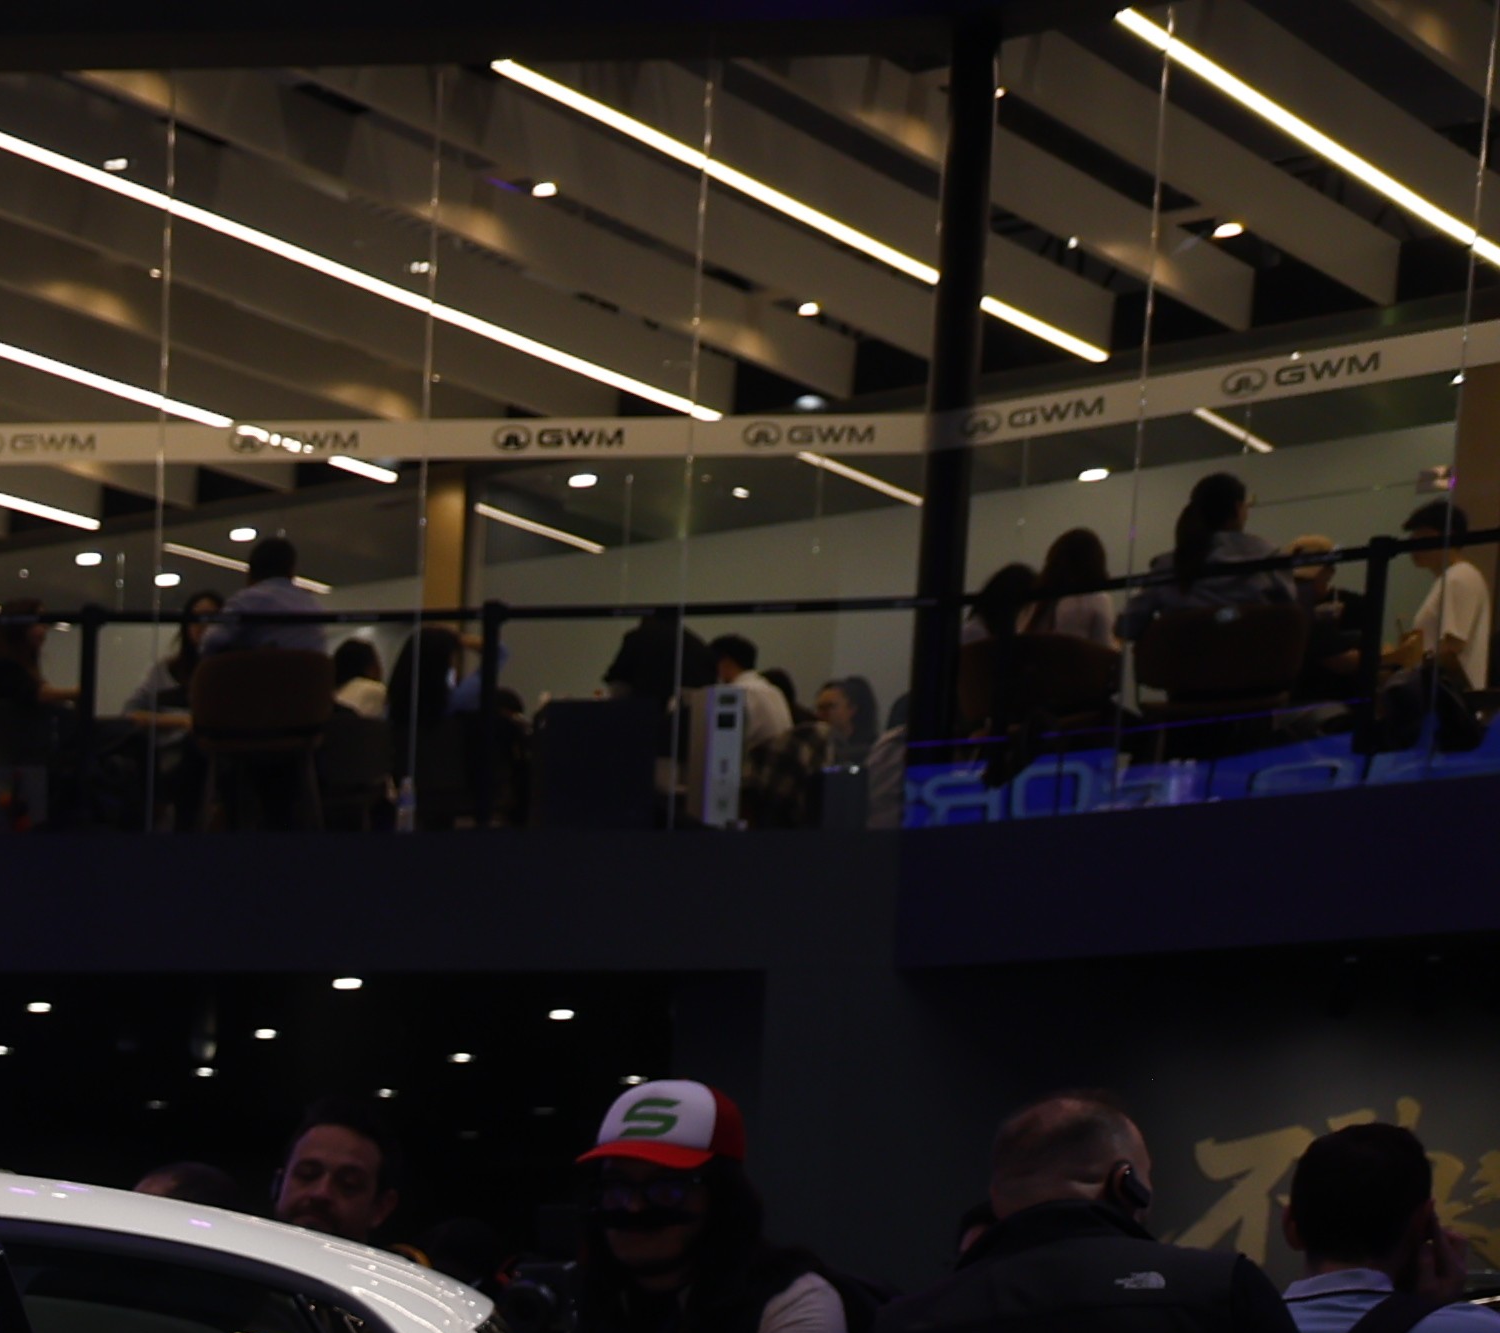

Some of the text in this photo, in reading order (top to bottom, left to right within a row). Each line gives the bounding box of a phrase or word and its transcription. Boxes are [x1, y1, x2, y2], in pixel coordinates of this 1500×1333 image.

[1275, 351, 1382, 387] GWM
[1008, 396, 1105, 430] GWM
[9, 432, 96, 456] GWM
[536, 426, 624, 450] GWM
[787, 423, 876, 448] GWM
